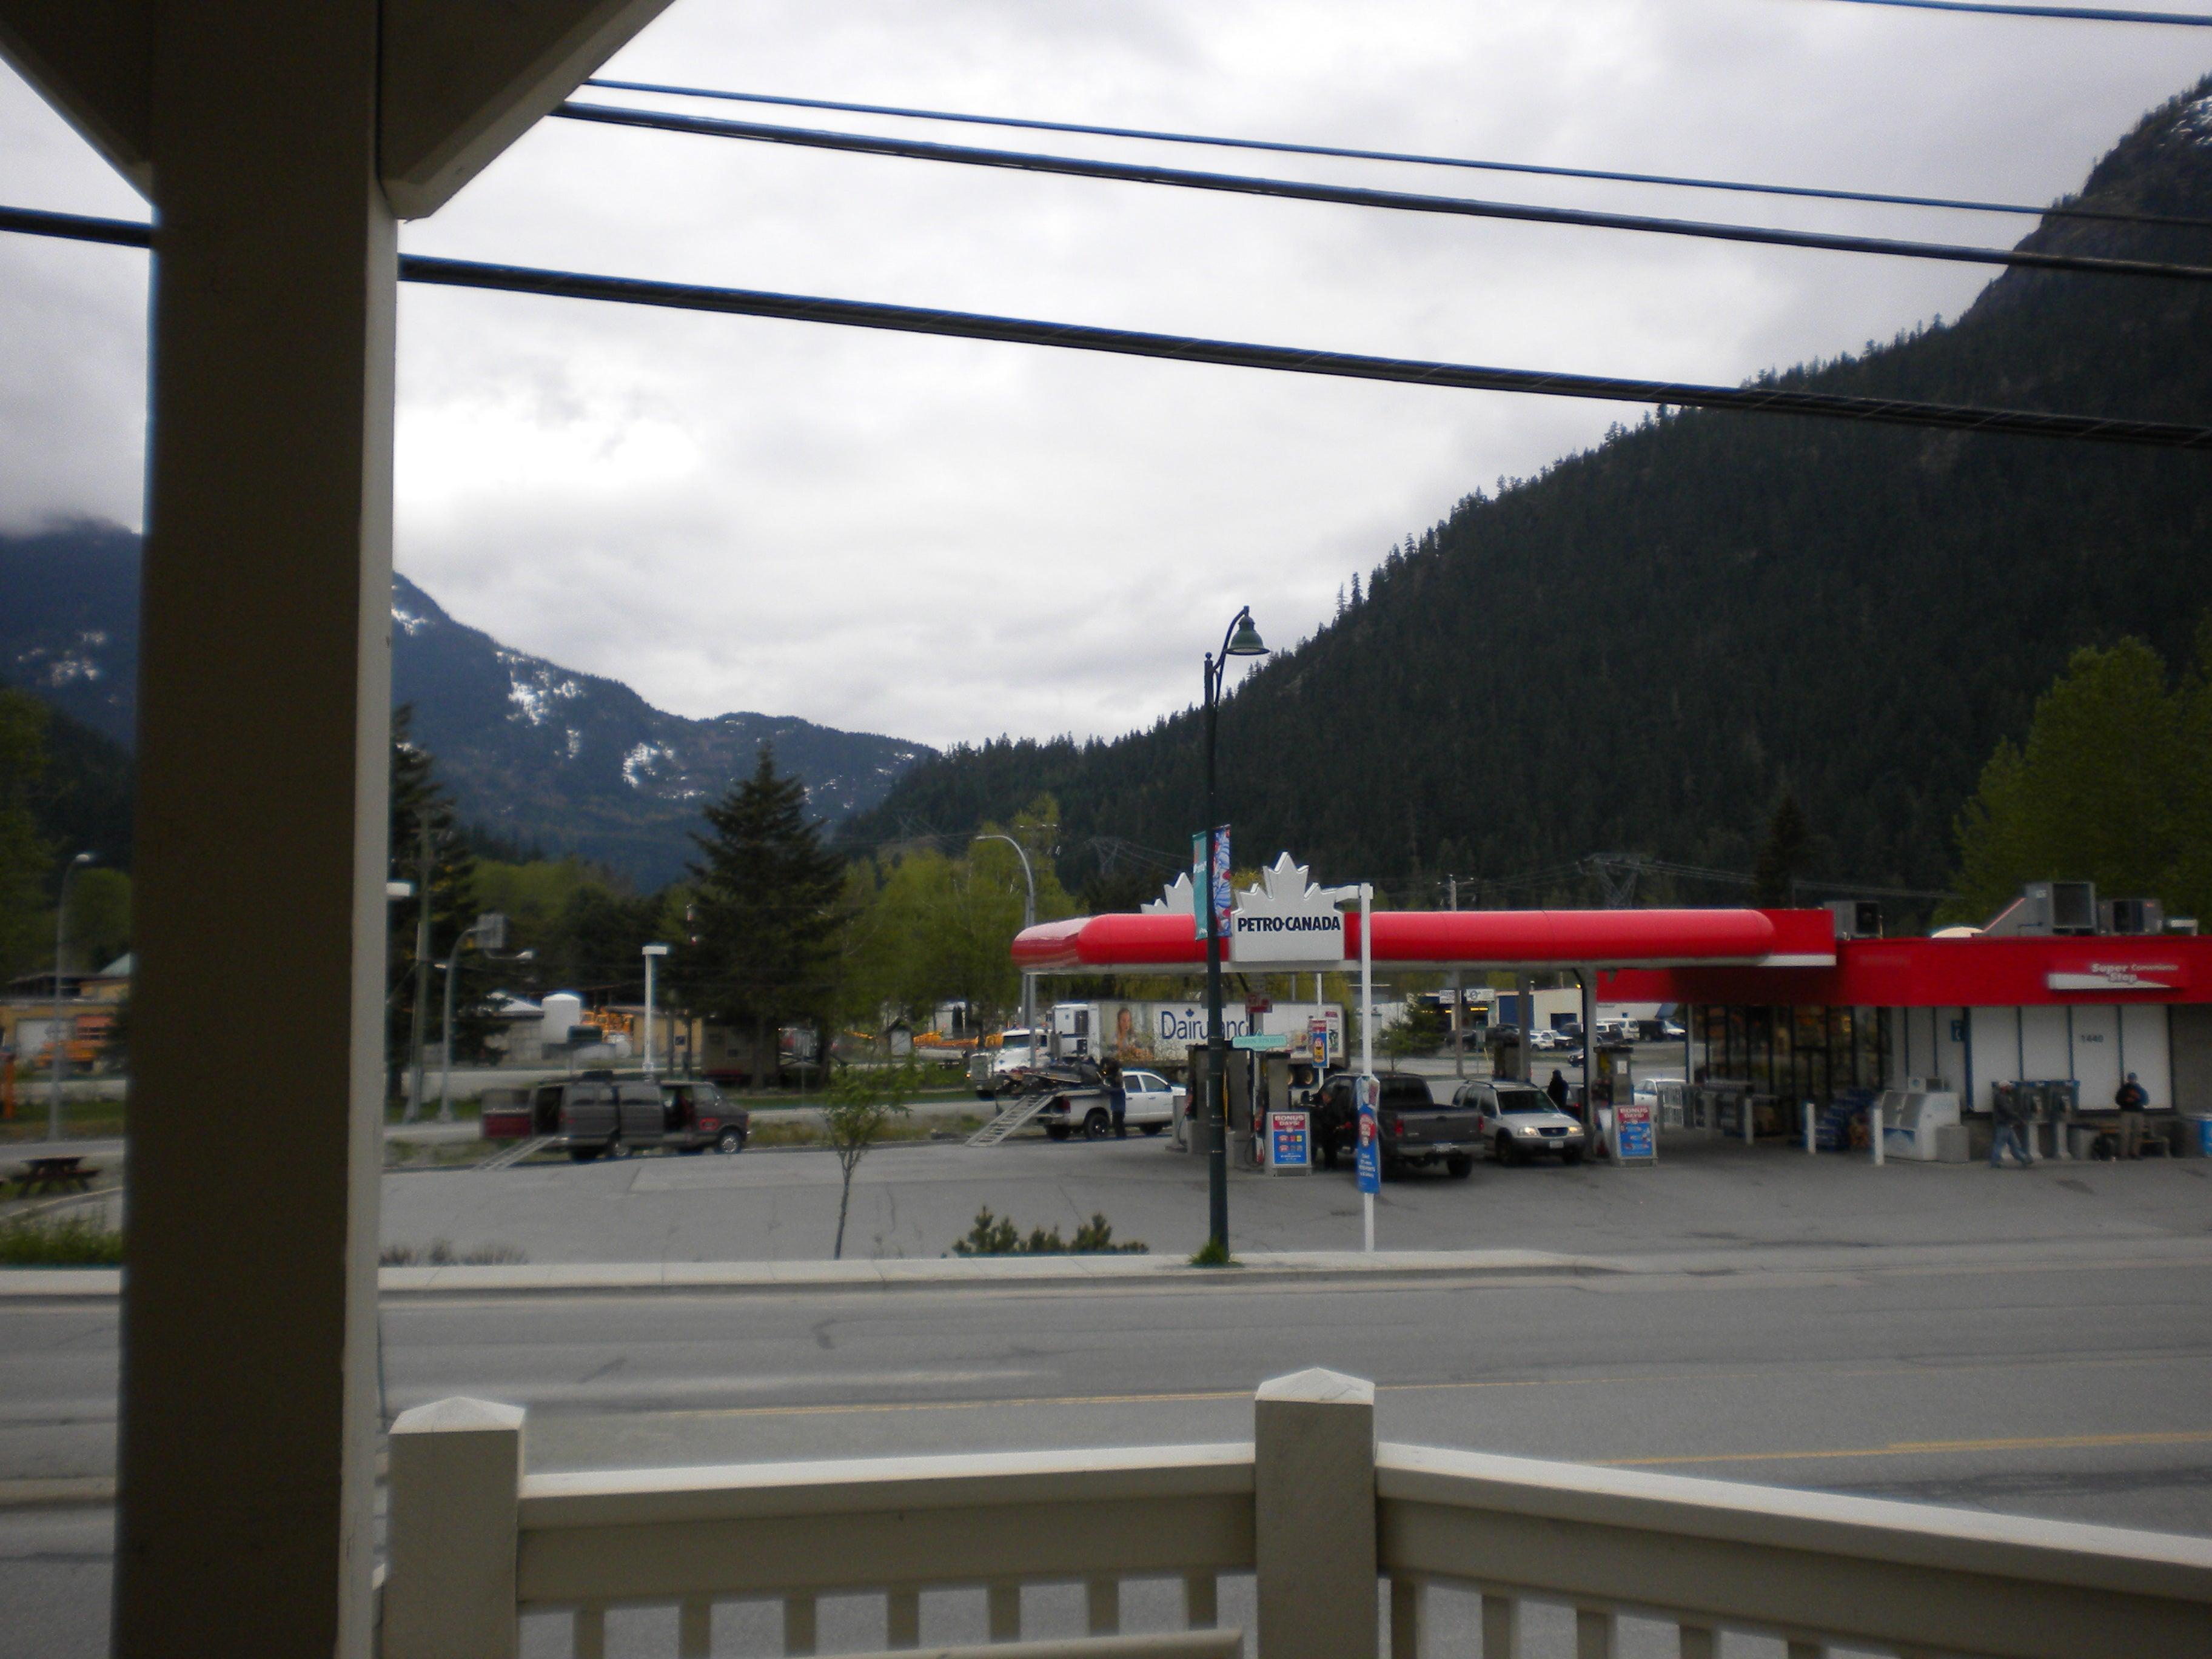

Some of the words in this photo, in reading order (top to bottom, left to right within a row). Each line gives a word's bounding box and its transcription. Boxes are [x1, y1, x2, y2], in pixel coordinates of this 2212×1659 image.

[2091, 964, 2128, 974] Super
[2109, 972, 2137, 984] Stop
[1161, 1010, 1250, 1039] Dairnd
